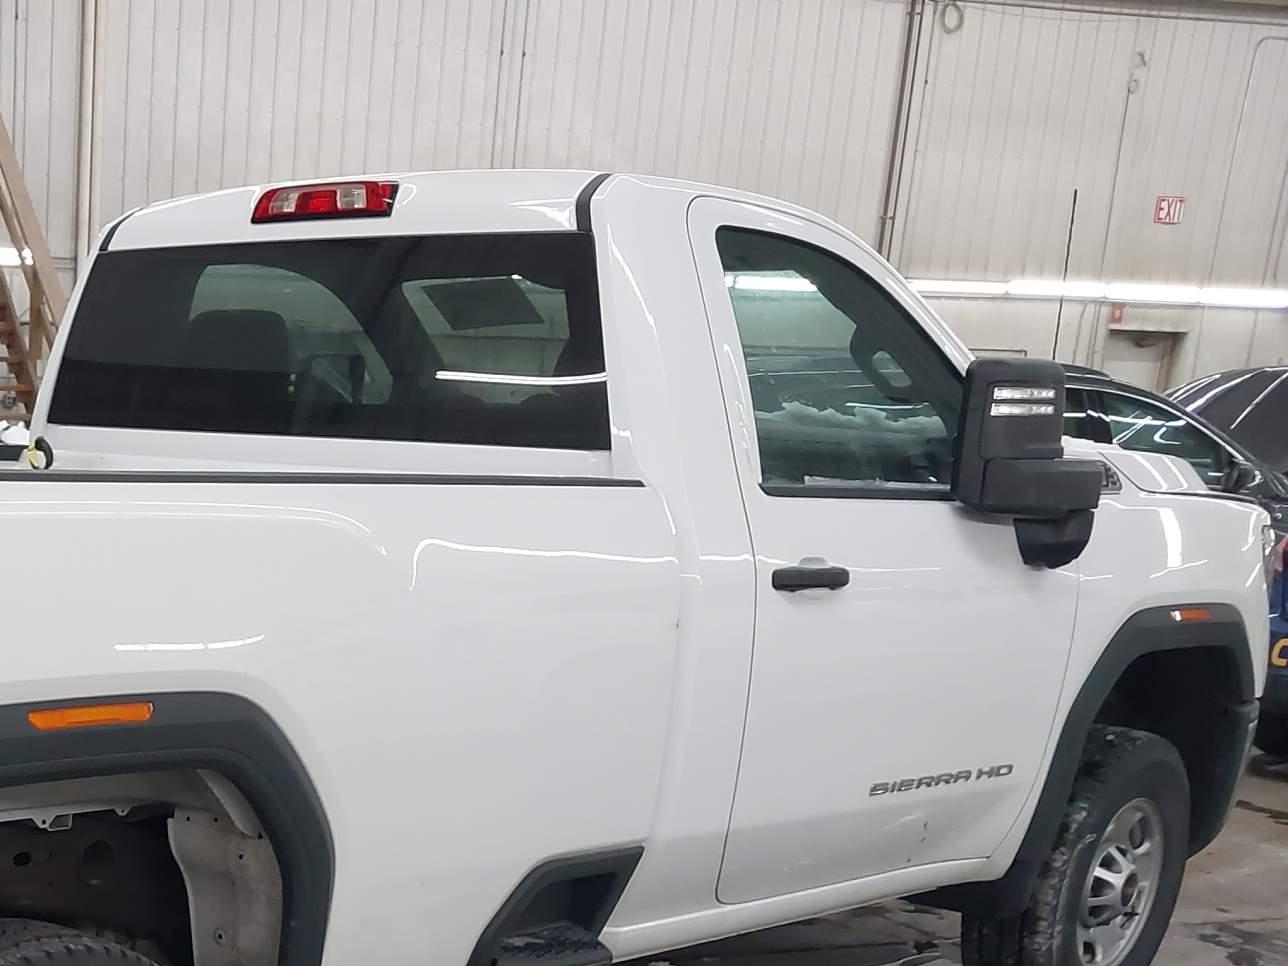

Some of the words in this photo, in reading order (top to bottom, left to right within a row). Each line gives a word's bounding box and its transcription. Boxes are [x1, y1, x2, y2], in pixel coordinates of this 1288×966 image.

[1157, 198, 1184, 222] EXIT
[869, 769, 972, 797] SIERRA
[975, 764, 1014, 780] HD
